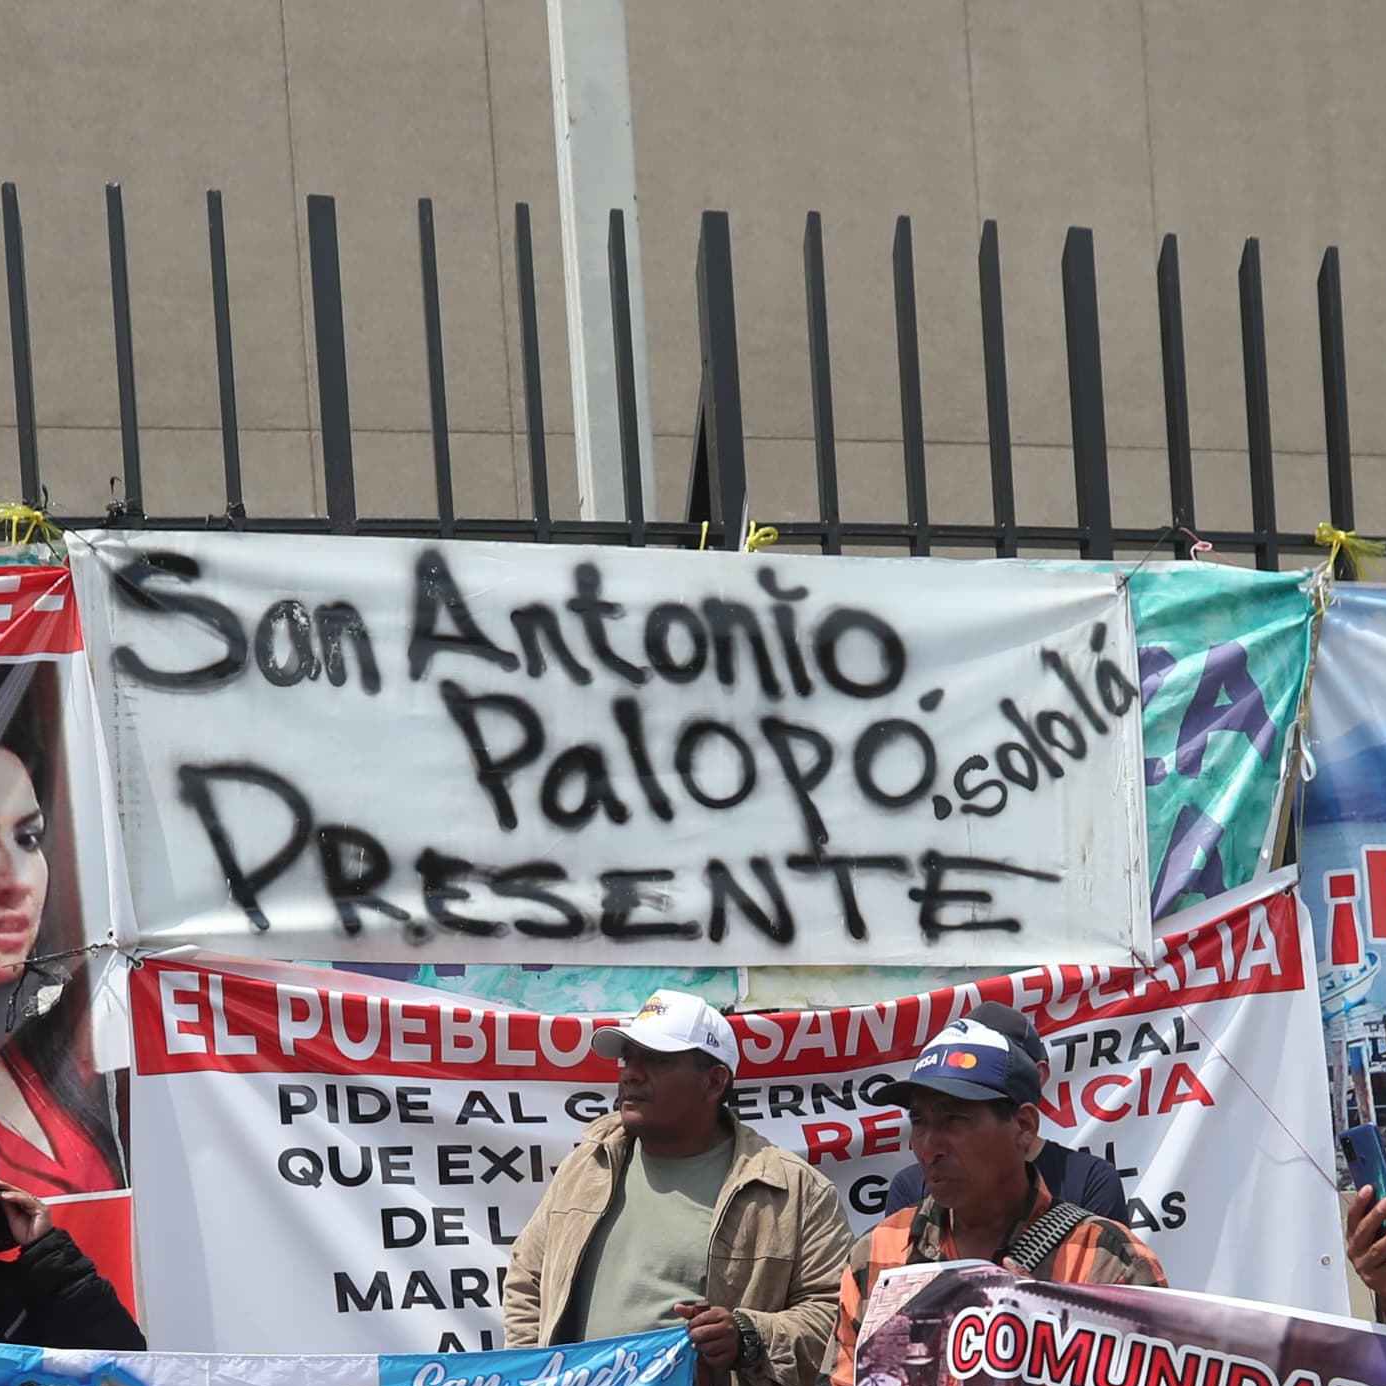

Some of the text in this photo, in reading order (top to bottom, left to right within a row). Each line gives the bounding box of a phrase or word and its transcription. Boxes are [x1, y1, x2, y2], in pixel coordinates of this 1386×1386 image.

[113, 549, 907, 700] San Antonio
[178, 760, 1063, 944] PRESENTE
[158, 970, 257, 1056] EL
[277, 982, 592, 1068] PUEBLO
[278, 1083, 434, 1126] PIDE
[455, 1090, 548, 1126] AL
[277, 1146, 413, 1188] QUE
[437, 1144, 559, 1186] EXI
[383, 1206, 469, 1249] DE
